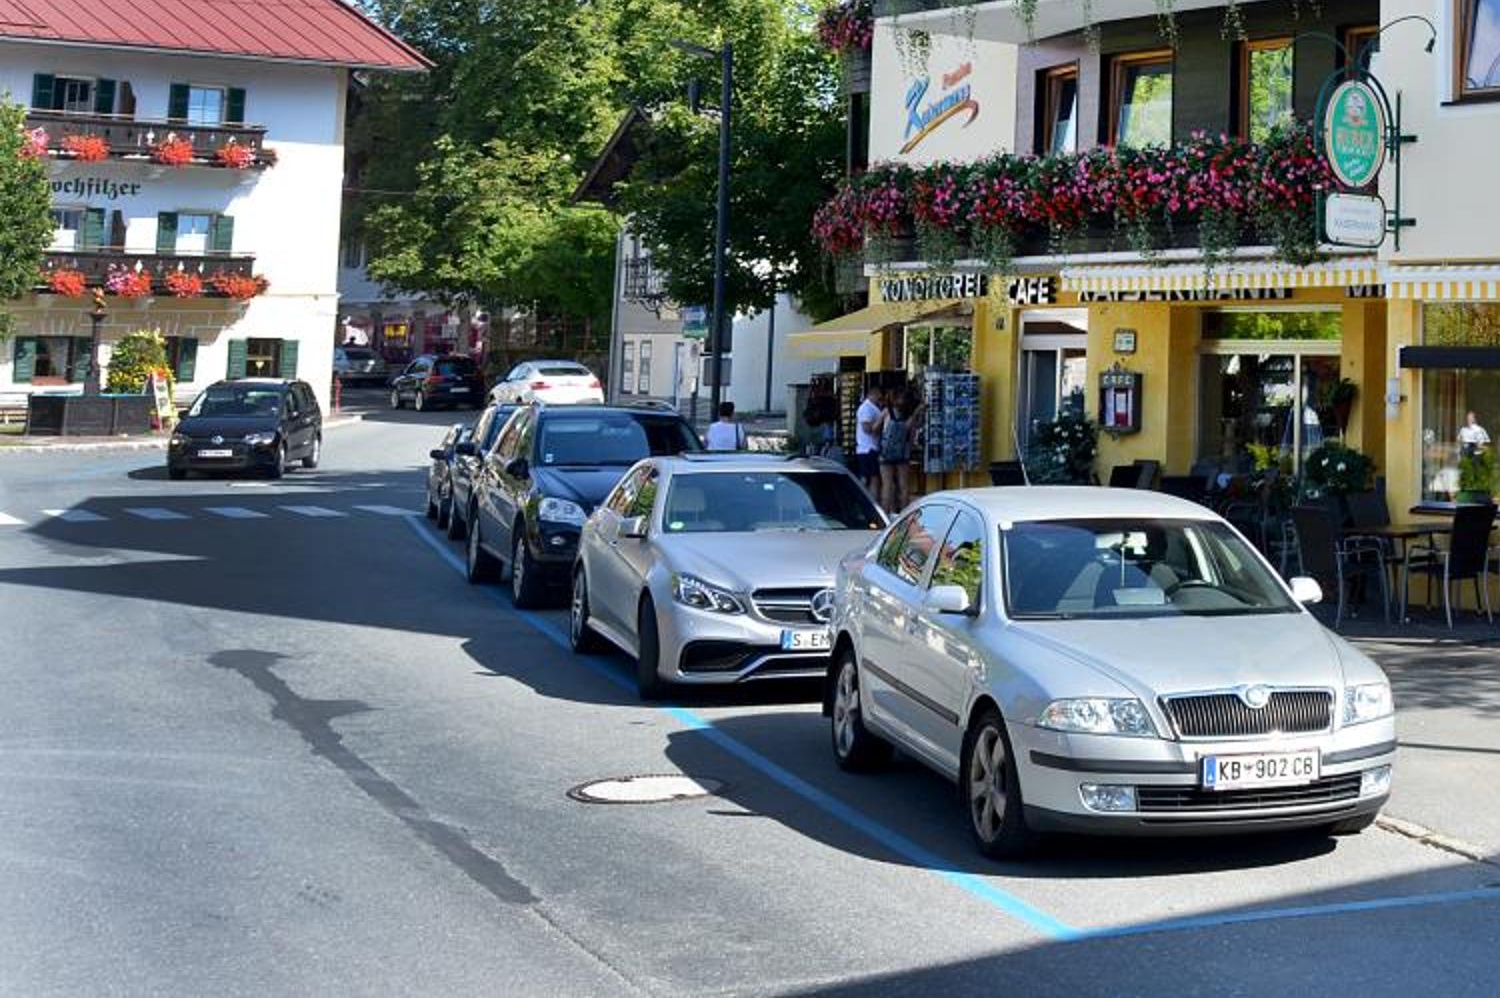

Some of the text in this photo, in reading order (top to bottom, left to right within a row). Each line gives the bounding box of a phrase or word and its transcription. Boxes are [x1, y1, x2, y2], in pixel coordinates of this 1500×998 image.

[51, 178, 141, 200] ochfilzer
[1219, 761, 1241, 781] KB
[1255, 758, 1288, 779] 902
